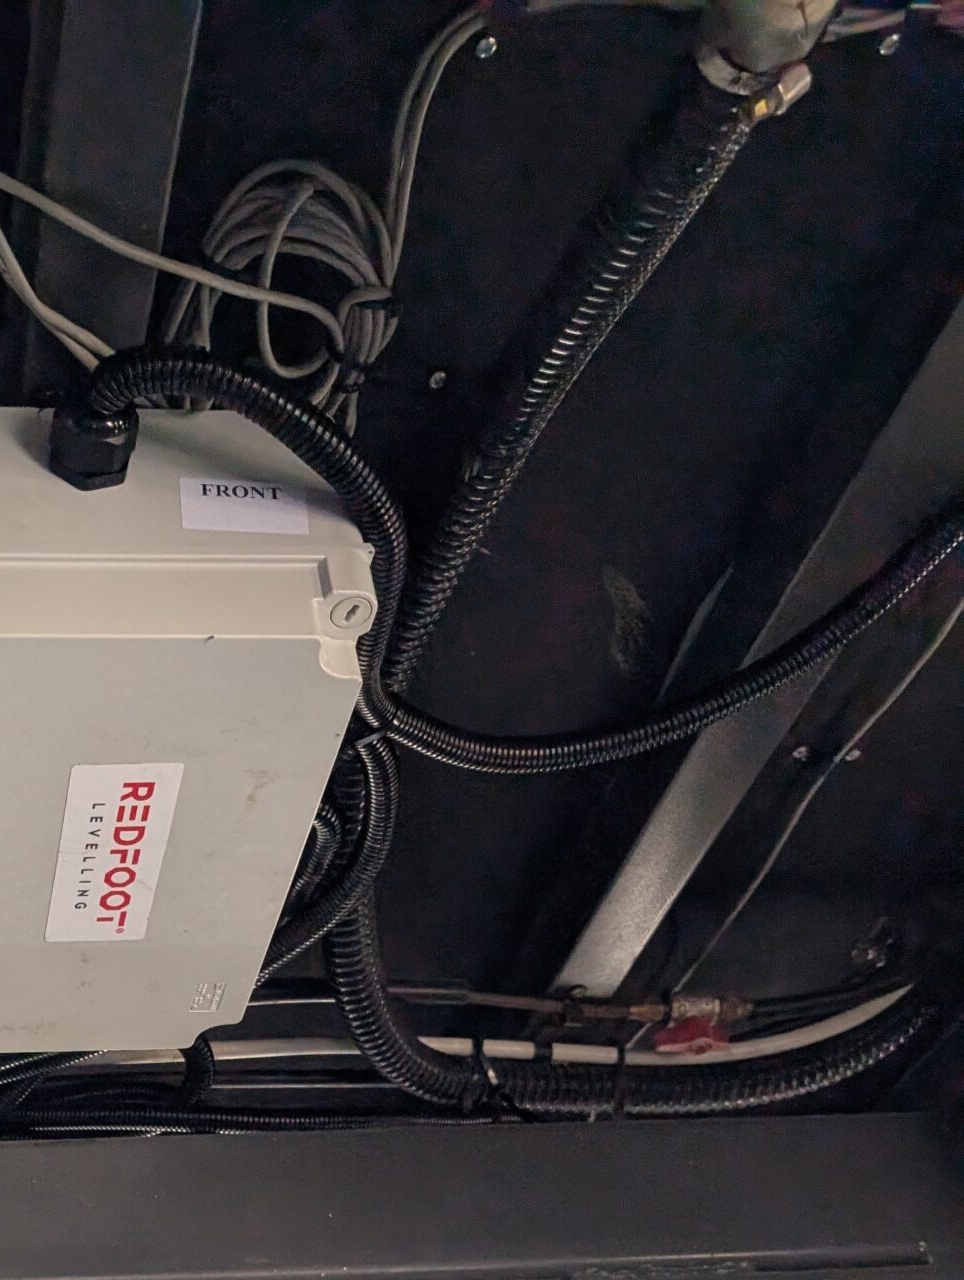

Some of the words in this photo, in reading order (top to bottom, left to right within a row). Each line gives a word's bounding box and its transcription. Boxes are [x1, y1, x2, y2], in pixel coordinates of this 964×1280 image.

[200, 483, 282, 500] FRONT
[74, 802, 106, 910] LEVELLING
[96, 781, 156, 927] REDFOOT
